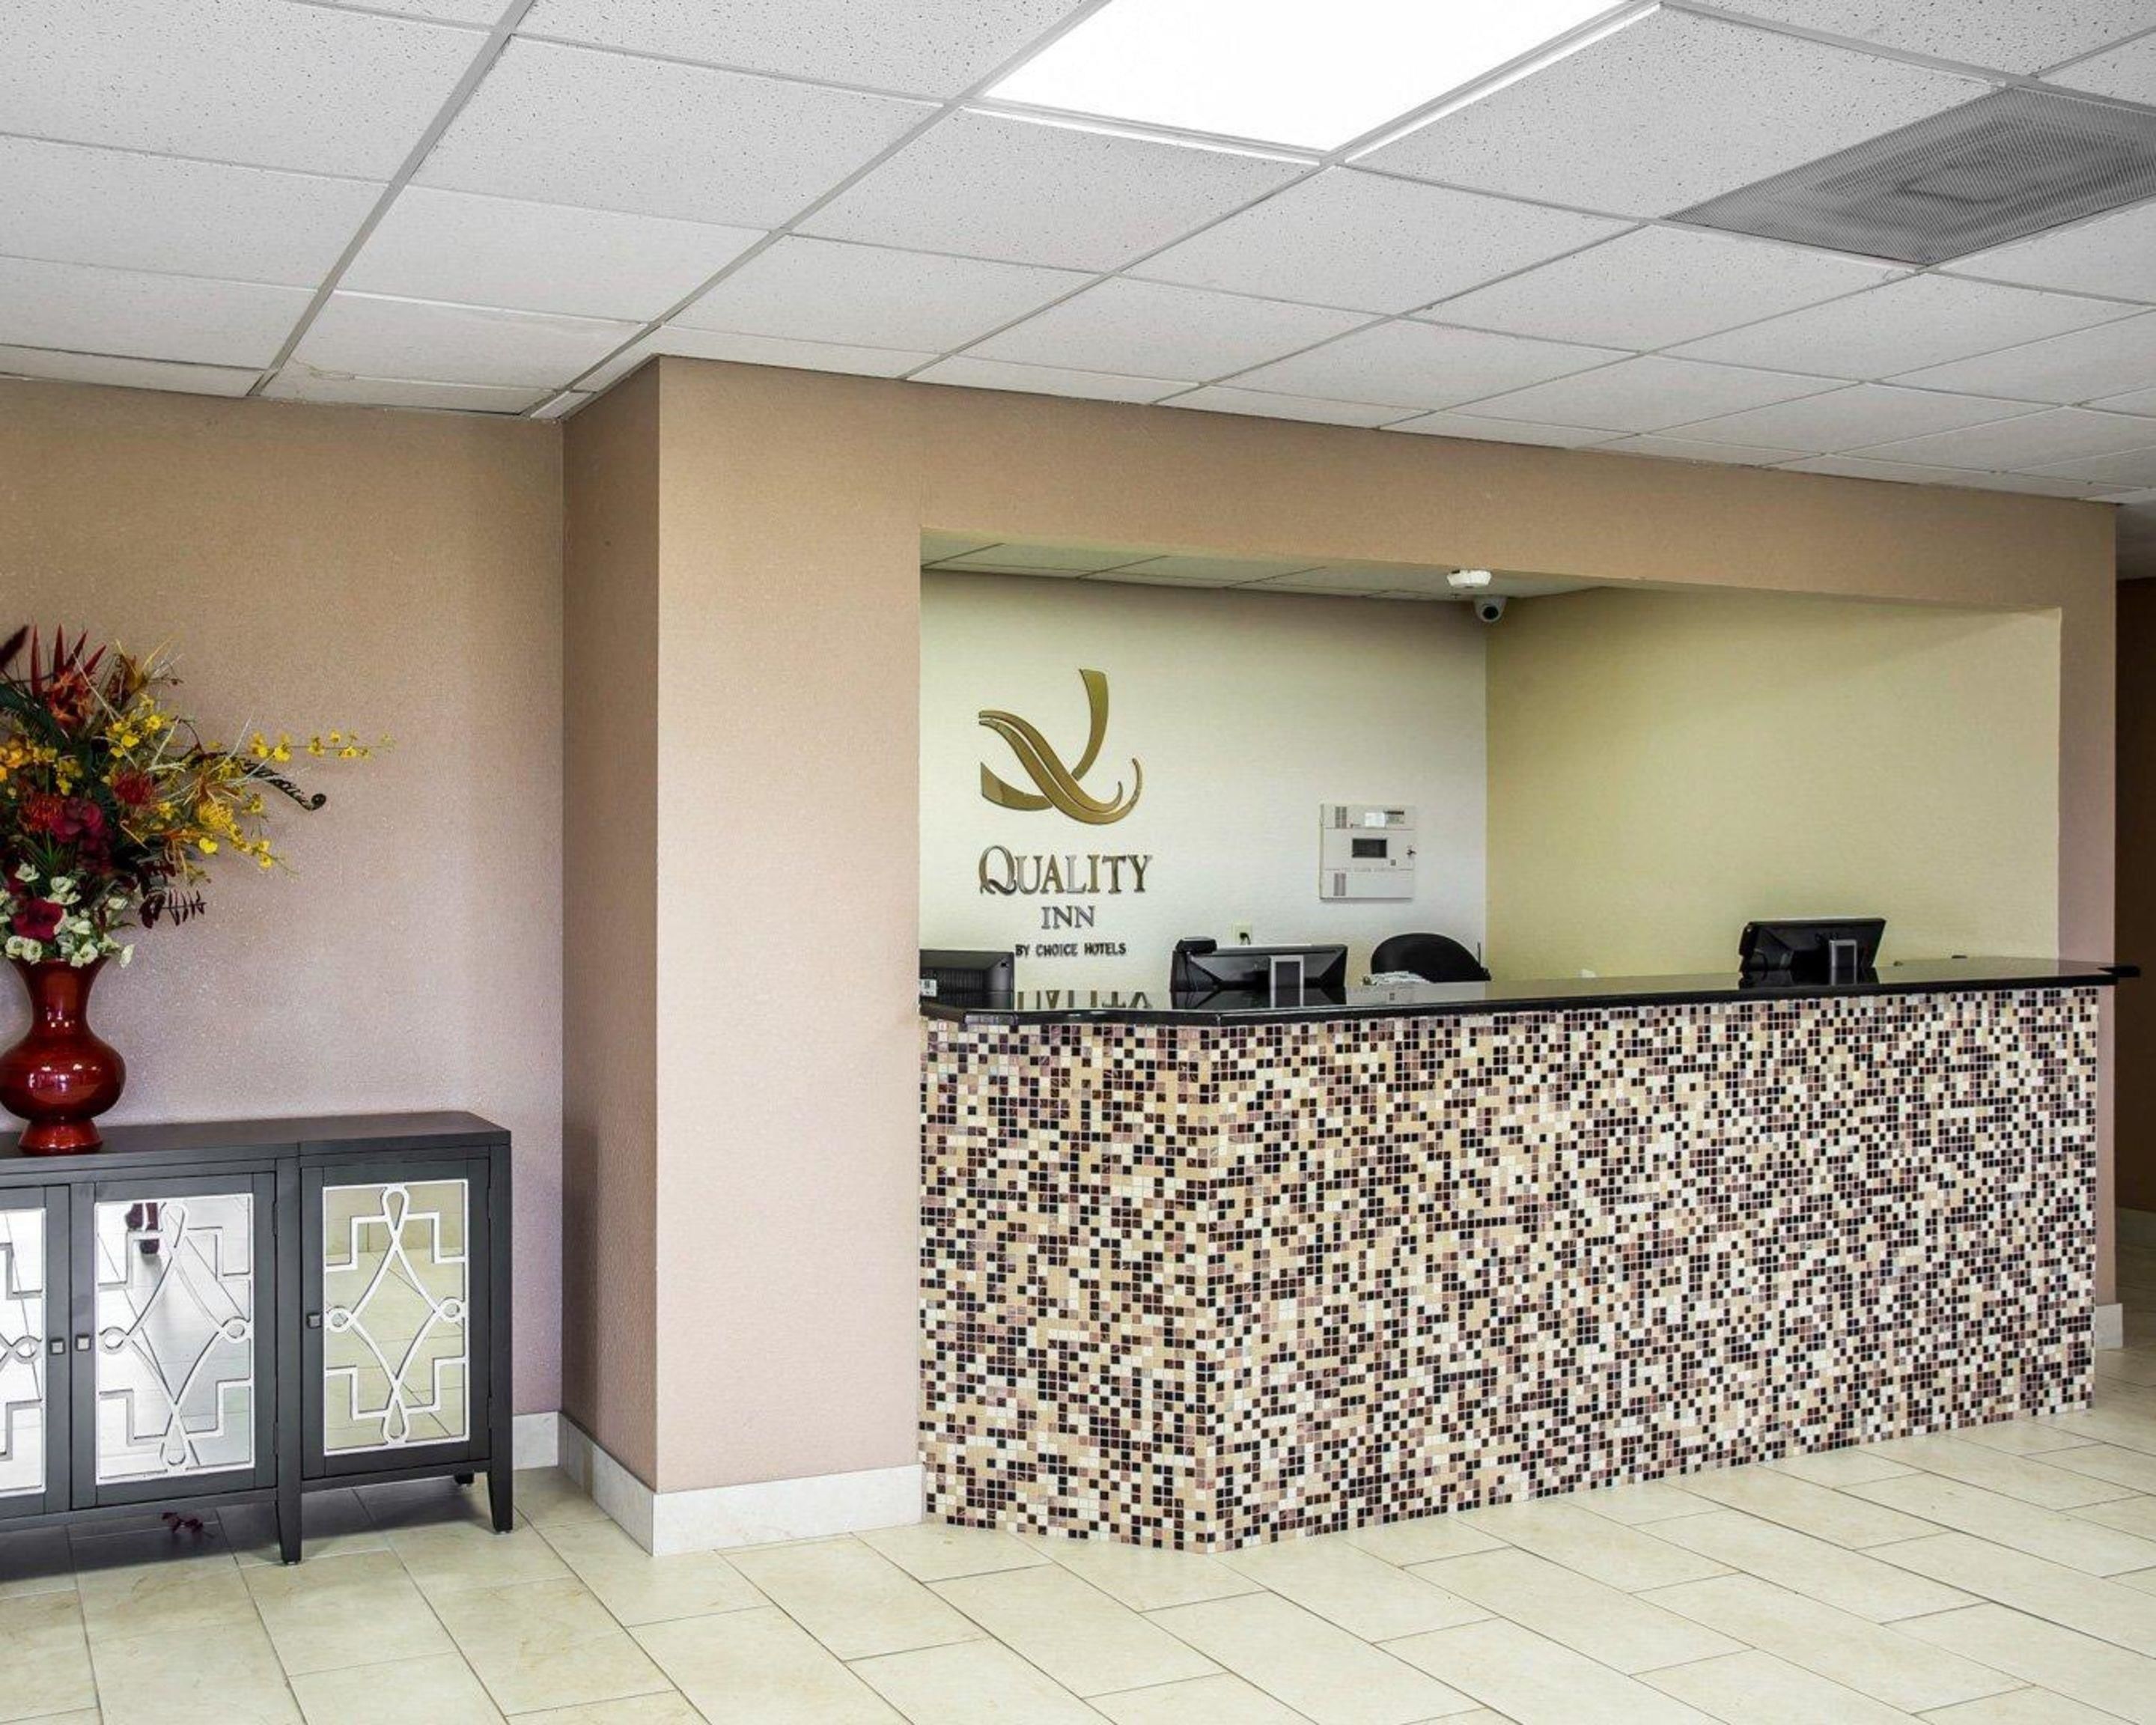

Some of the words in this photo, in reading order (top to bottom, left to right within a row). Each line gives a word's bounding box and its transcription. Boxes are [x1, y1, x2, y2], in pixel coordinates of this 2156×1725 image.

[978, 845, 1153, 895] QUALITY
[1041, 905, 1095, 929] INN
[1015, 943, 1031, 958] BY
[1036, 943, 1078, 957] CHOICE
[1084, 942, 1127, 955] HOTELS
